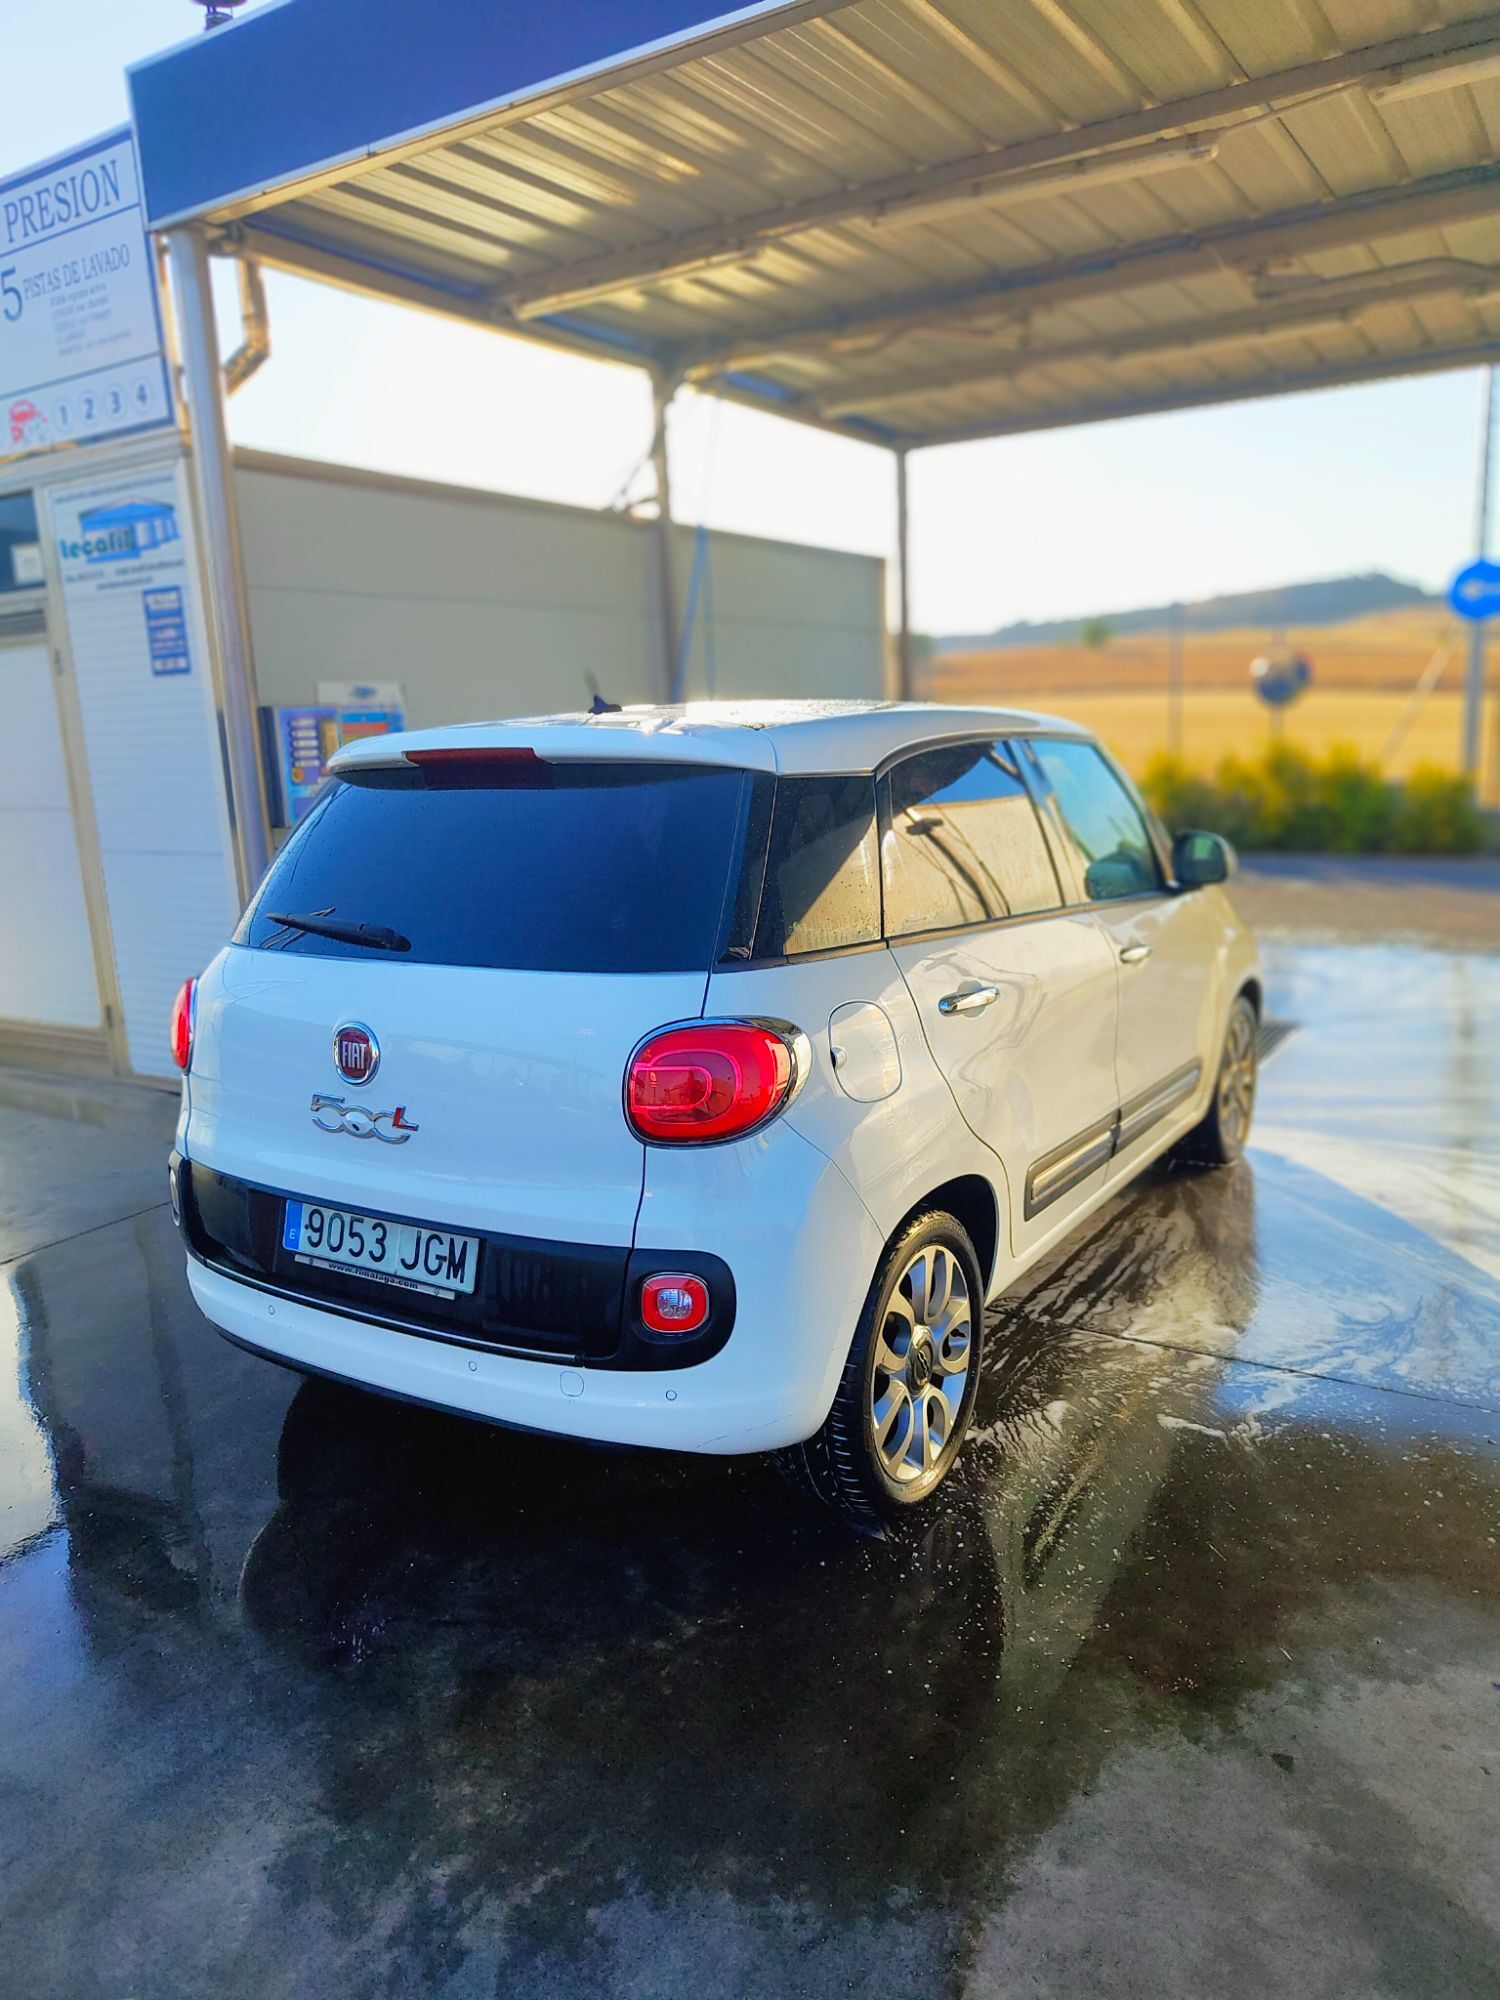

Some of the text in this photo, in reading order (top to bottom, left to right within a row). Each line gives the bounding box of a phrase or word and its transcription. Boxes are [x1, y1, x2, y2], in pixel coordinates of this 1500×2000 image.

[4, 160, 122, 243] PRESION
[0, 265, 23, 322] 5
[22, 266, 61, 300] PISTAS
[62, 260, 81, 287] DE
[81, 243, 130, 280] LAVADO
[59, 383, 148, 426] 1 2 3 4
[342, 1040, 367, 1070] FIAT
[289, 1208, 469, 1284] E 9053 JGM
